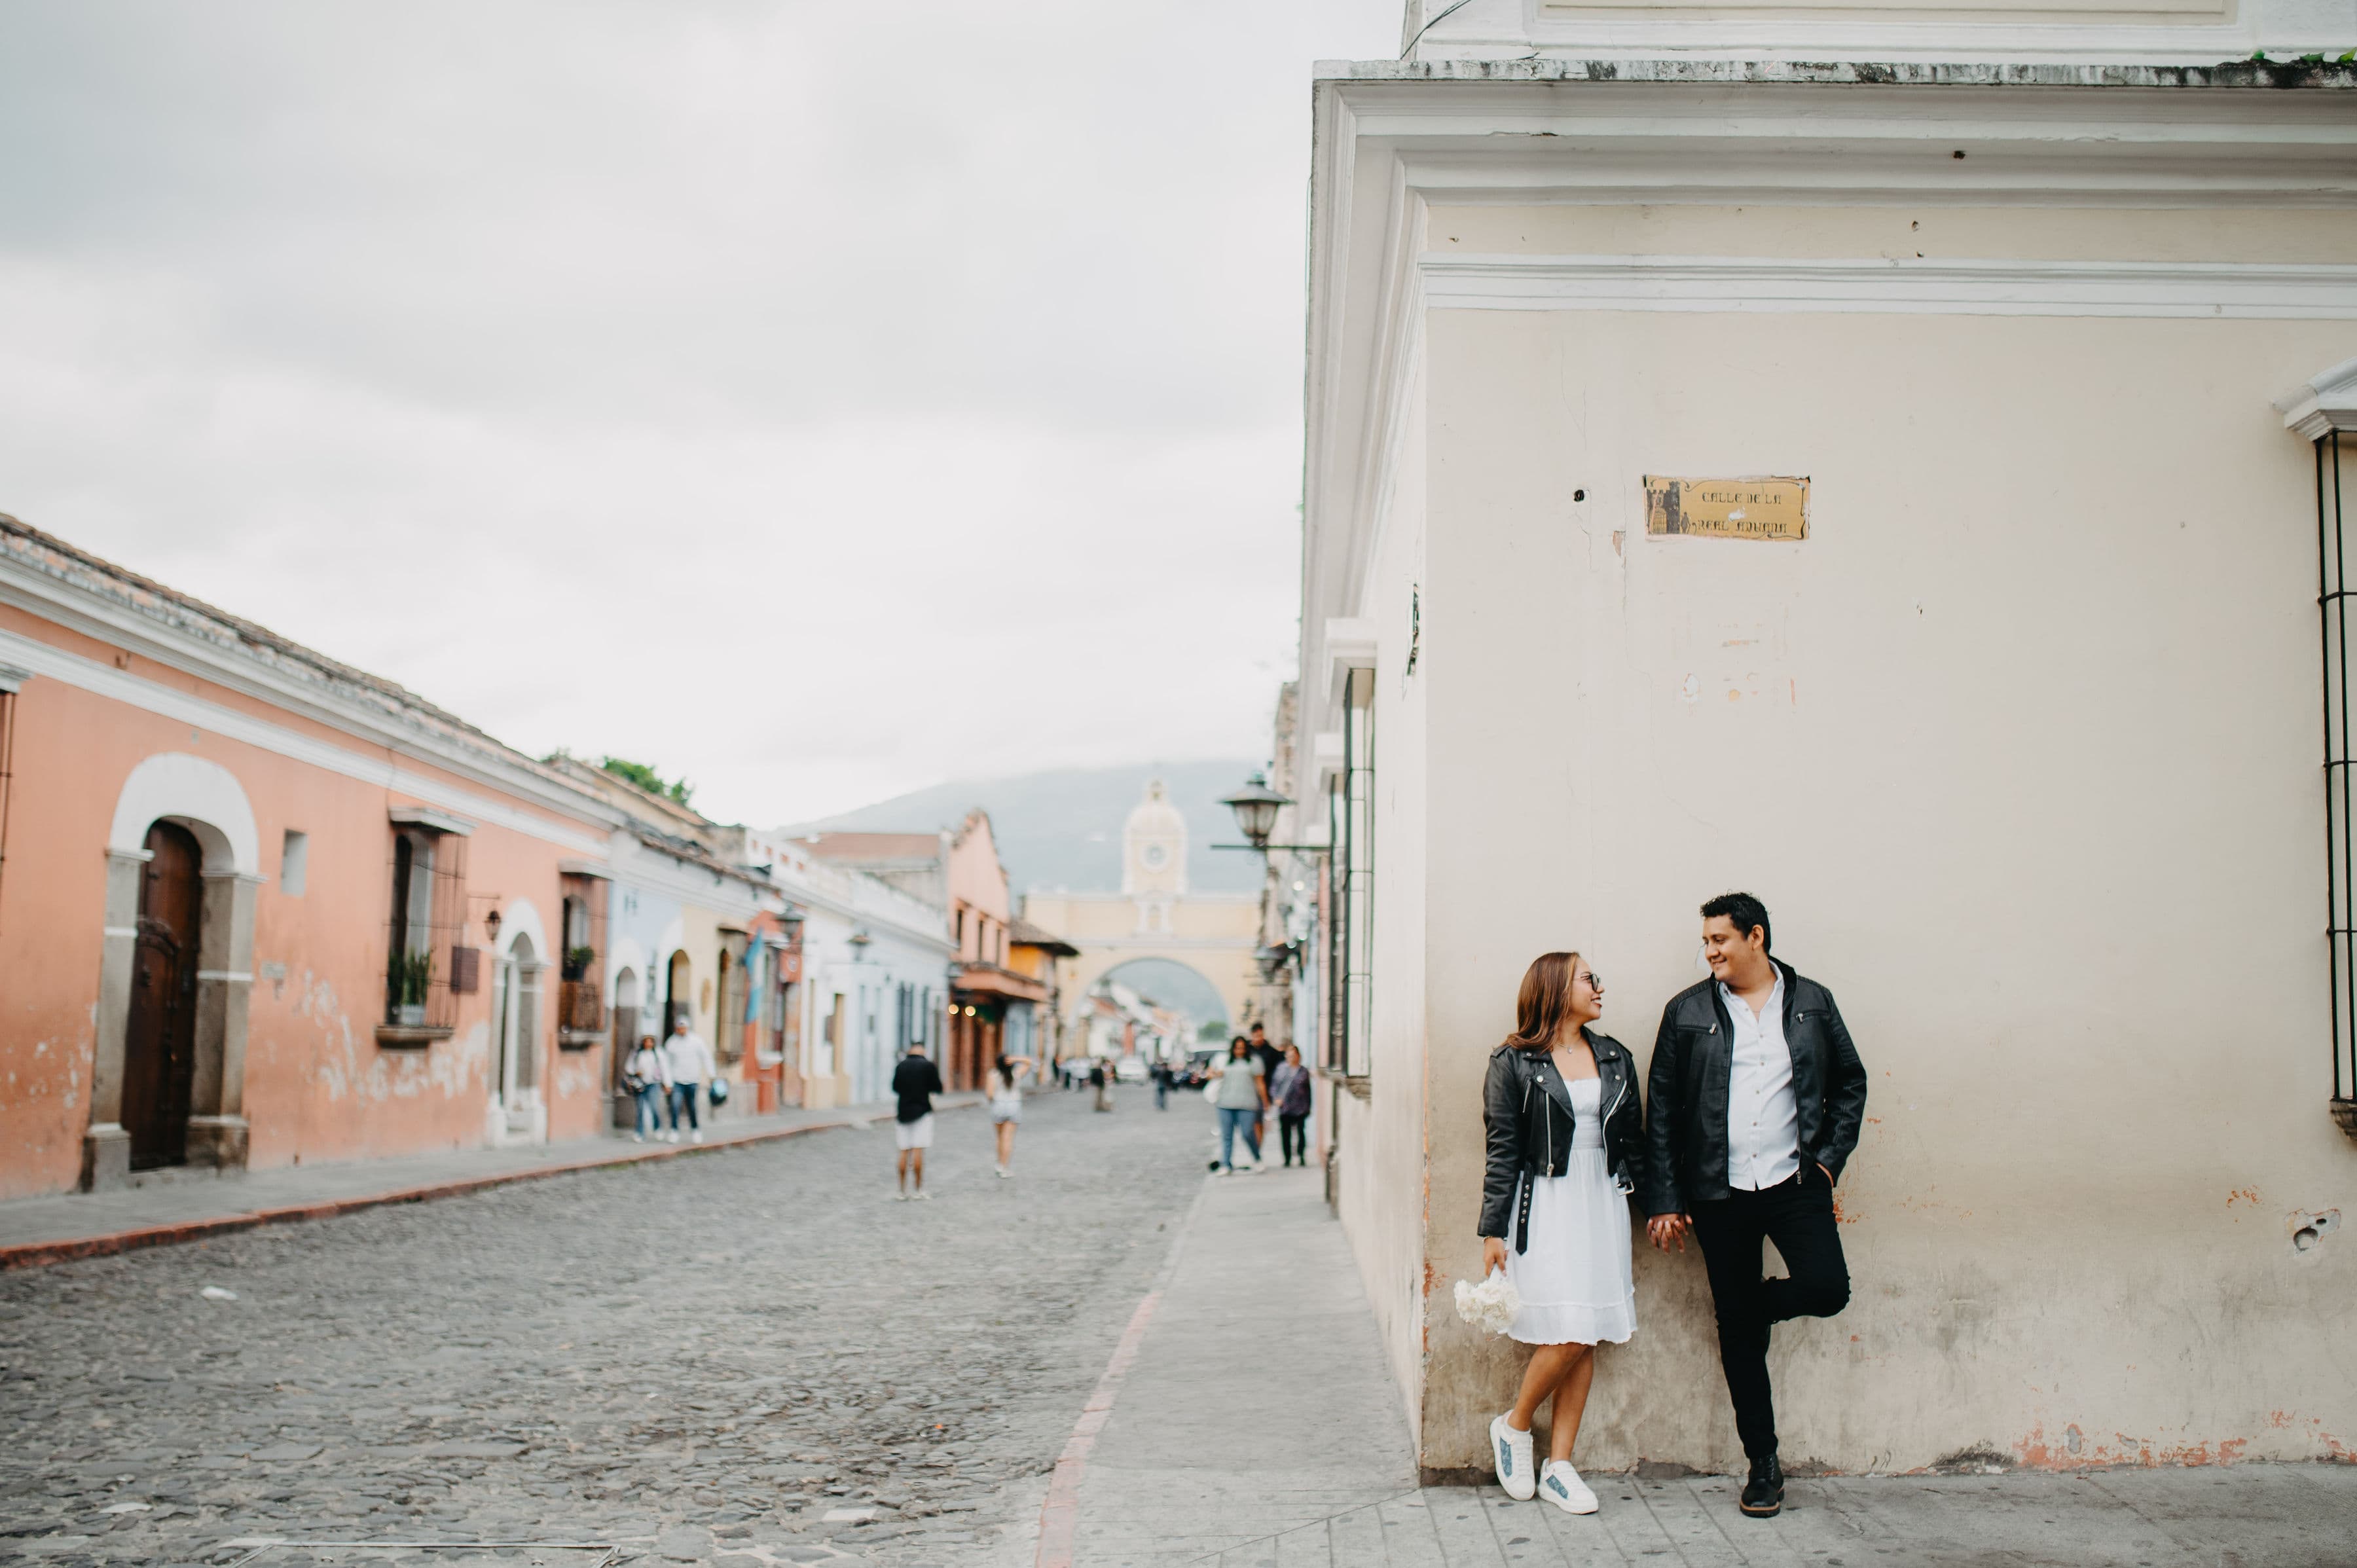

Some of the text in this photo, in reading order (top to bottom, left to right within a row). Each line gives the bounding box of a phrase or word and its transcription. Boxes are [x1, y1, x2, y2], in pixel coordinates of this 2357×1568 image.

[1702, 492, 1781, 505] CALLE DE LA
[1698, 519, 1787, 534] REAL ADUANA
